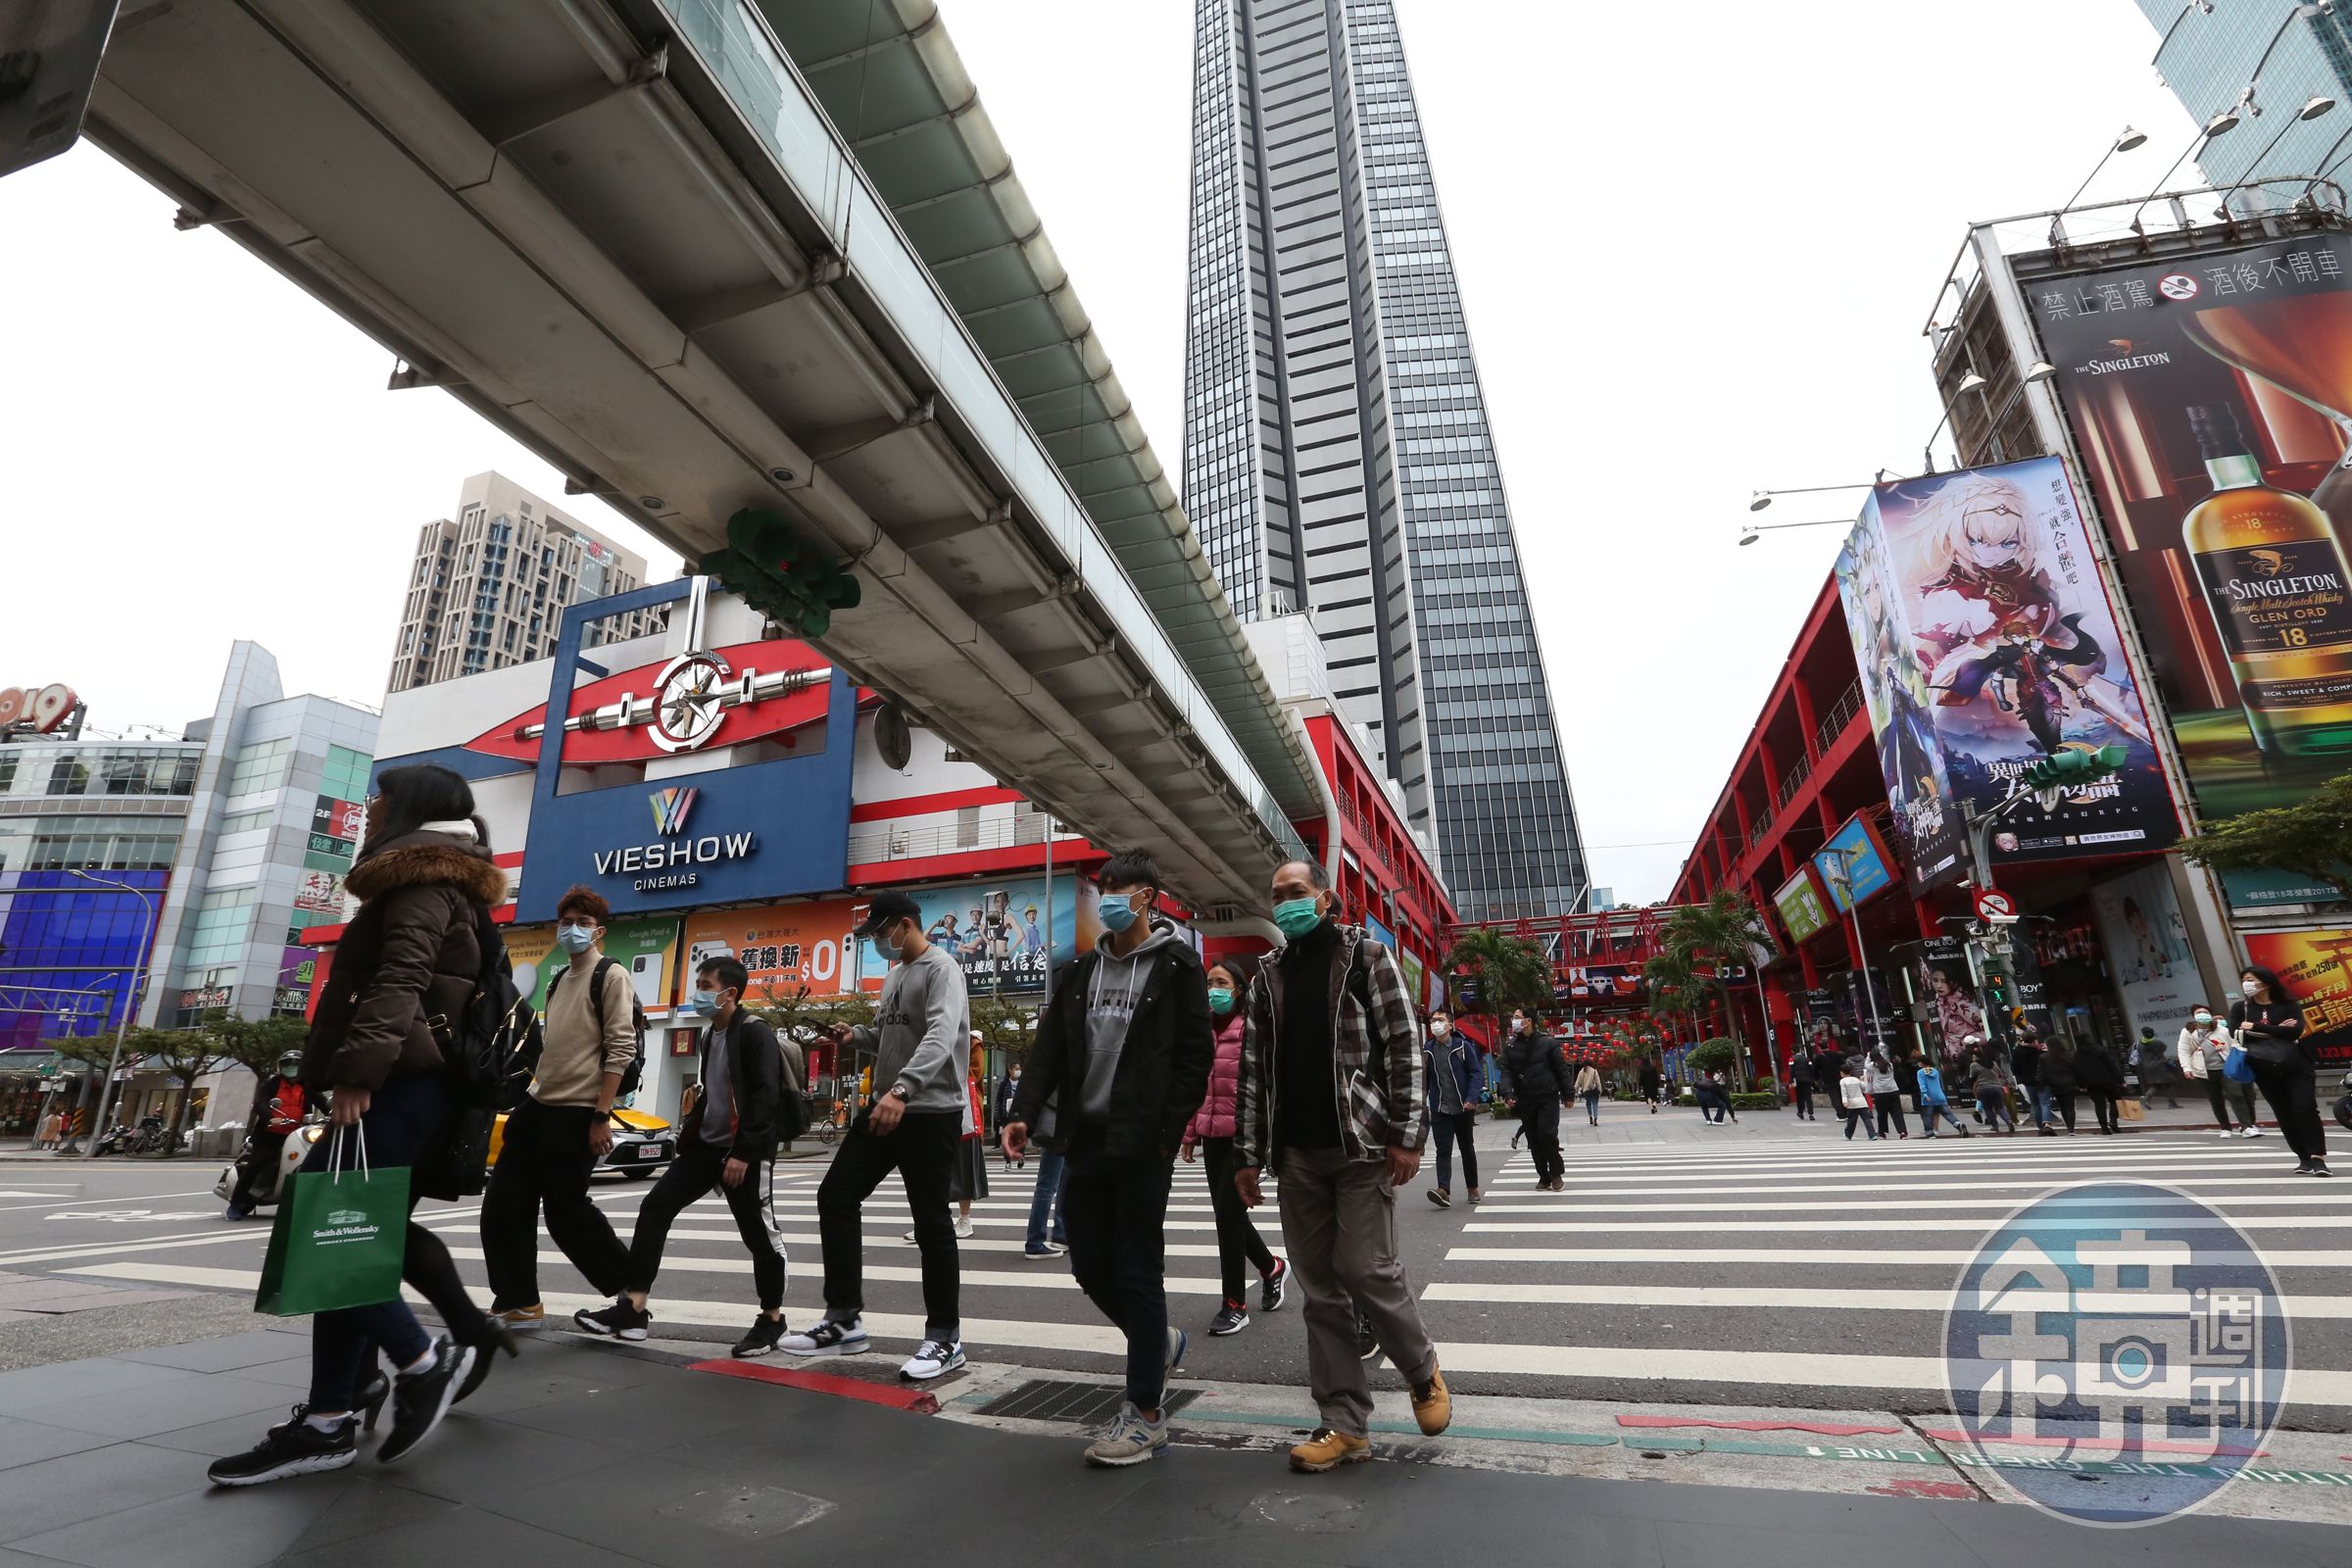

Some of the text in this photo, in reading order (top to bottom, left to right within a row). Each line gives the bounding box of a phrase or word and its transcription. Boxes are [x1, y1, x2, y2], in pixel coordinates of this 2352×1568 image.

[2042, 248, 2343, 321] 禁止酒駕 酒後不開車
[2075, 353, 2170, 375] THE SINGLETON
[2246, 518, 2262, 529] 18
[2213, 587, 2230, 596] THE
[2314, 592, 2343, 606] Whisky
[2249, 607, 2328, 623] GLEN ORD
[2278, 627, 2308, 647] 18
[316, 808, 331, 818] 2F
[594, 832, 753, 875] VIESHOW
[634, 873, 697, 891] CINEMAS
[757, 928, 800, 940] 台灣大哥大
[741, 944, 801, 972] 舊換新
[1994, 976, 2002, 985] 4
[2020, 984, 2038, 993] BOY
[1838, 1446, 2352, 1486] ITHIN THE GREEN LINE
